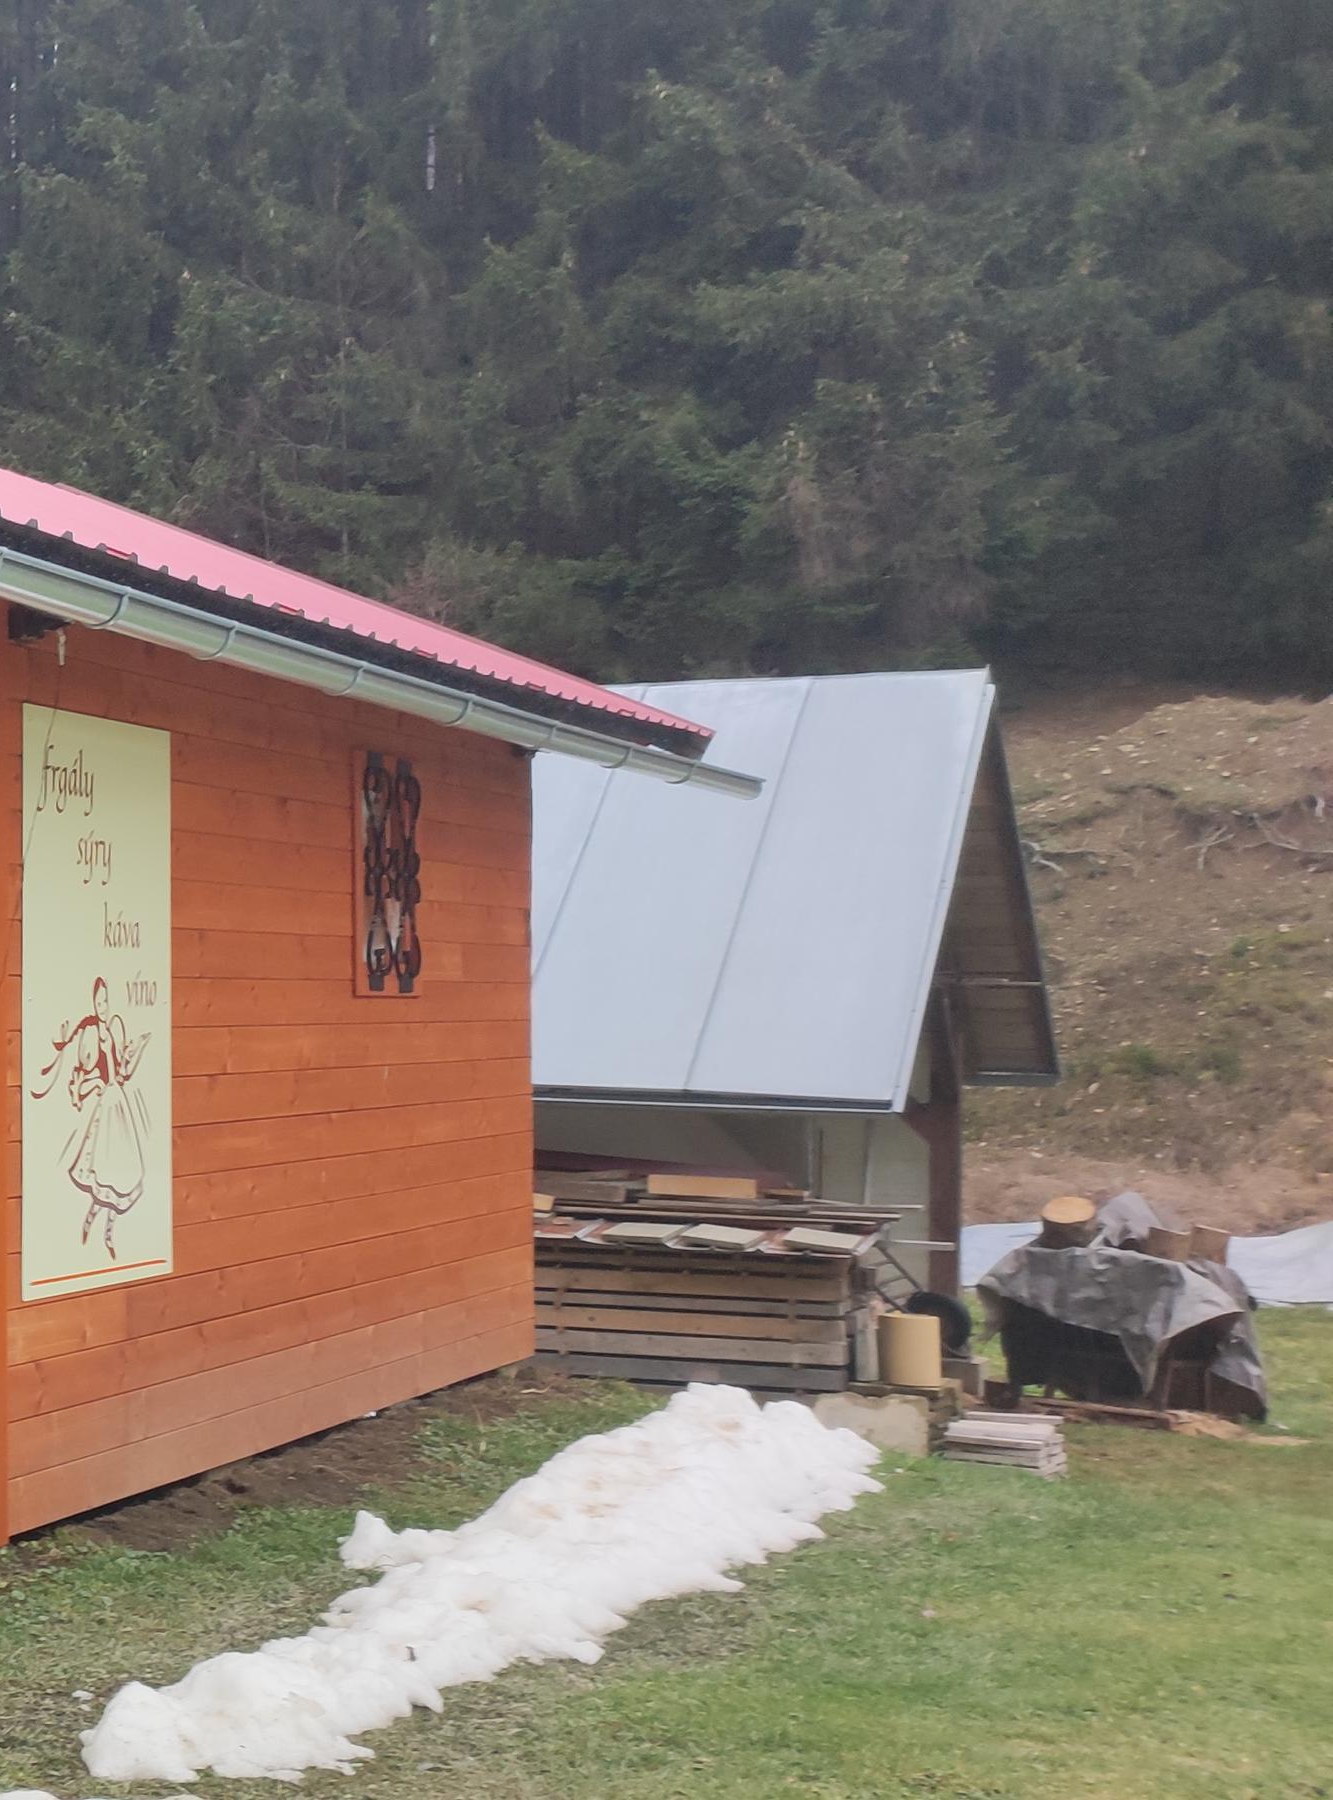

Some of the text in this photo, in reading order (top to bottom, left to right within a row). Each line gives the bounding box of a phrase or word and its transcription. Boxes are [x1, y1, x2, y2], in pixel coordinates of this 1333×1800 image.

[36, 744, 94, 817] frgály
[76, 830, 112, 885] sýry
[103, 901, 141, 948] káva
[125, 970, 157, 1007] víno
